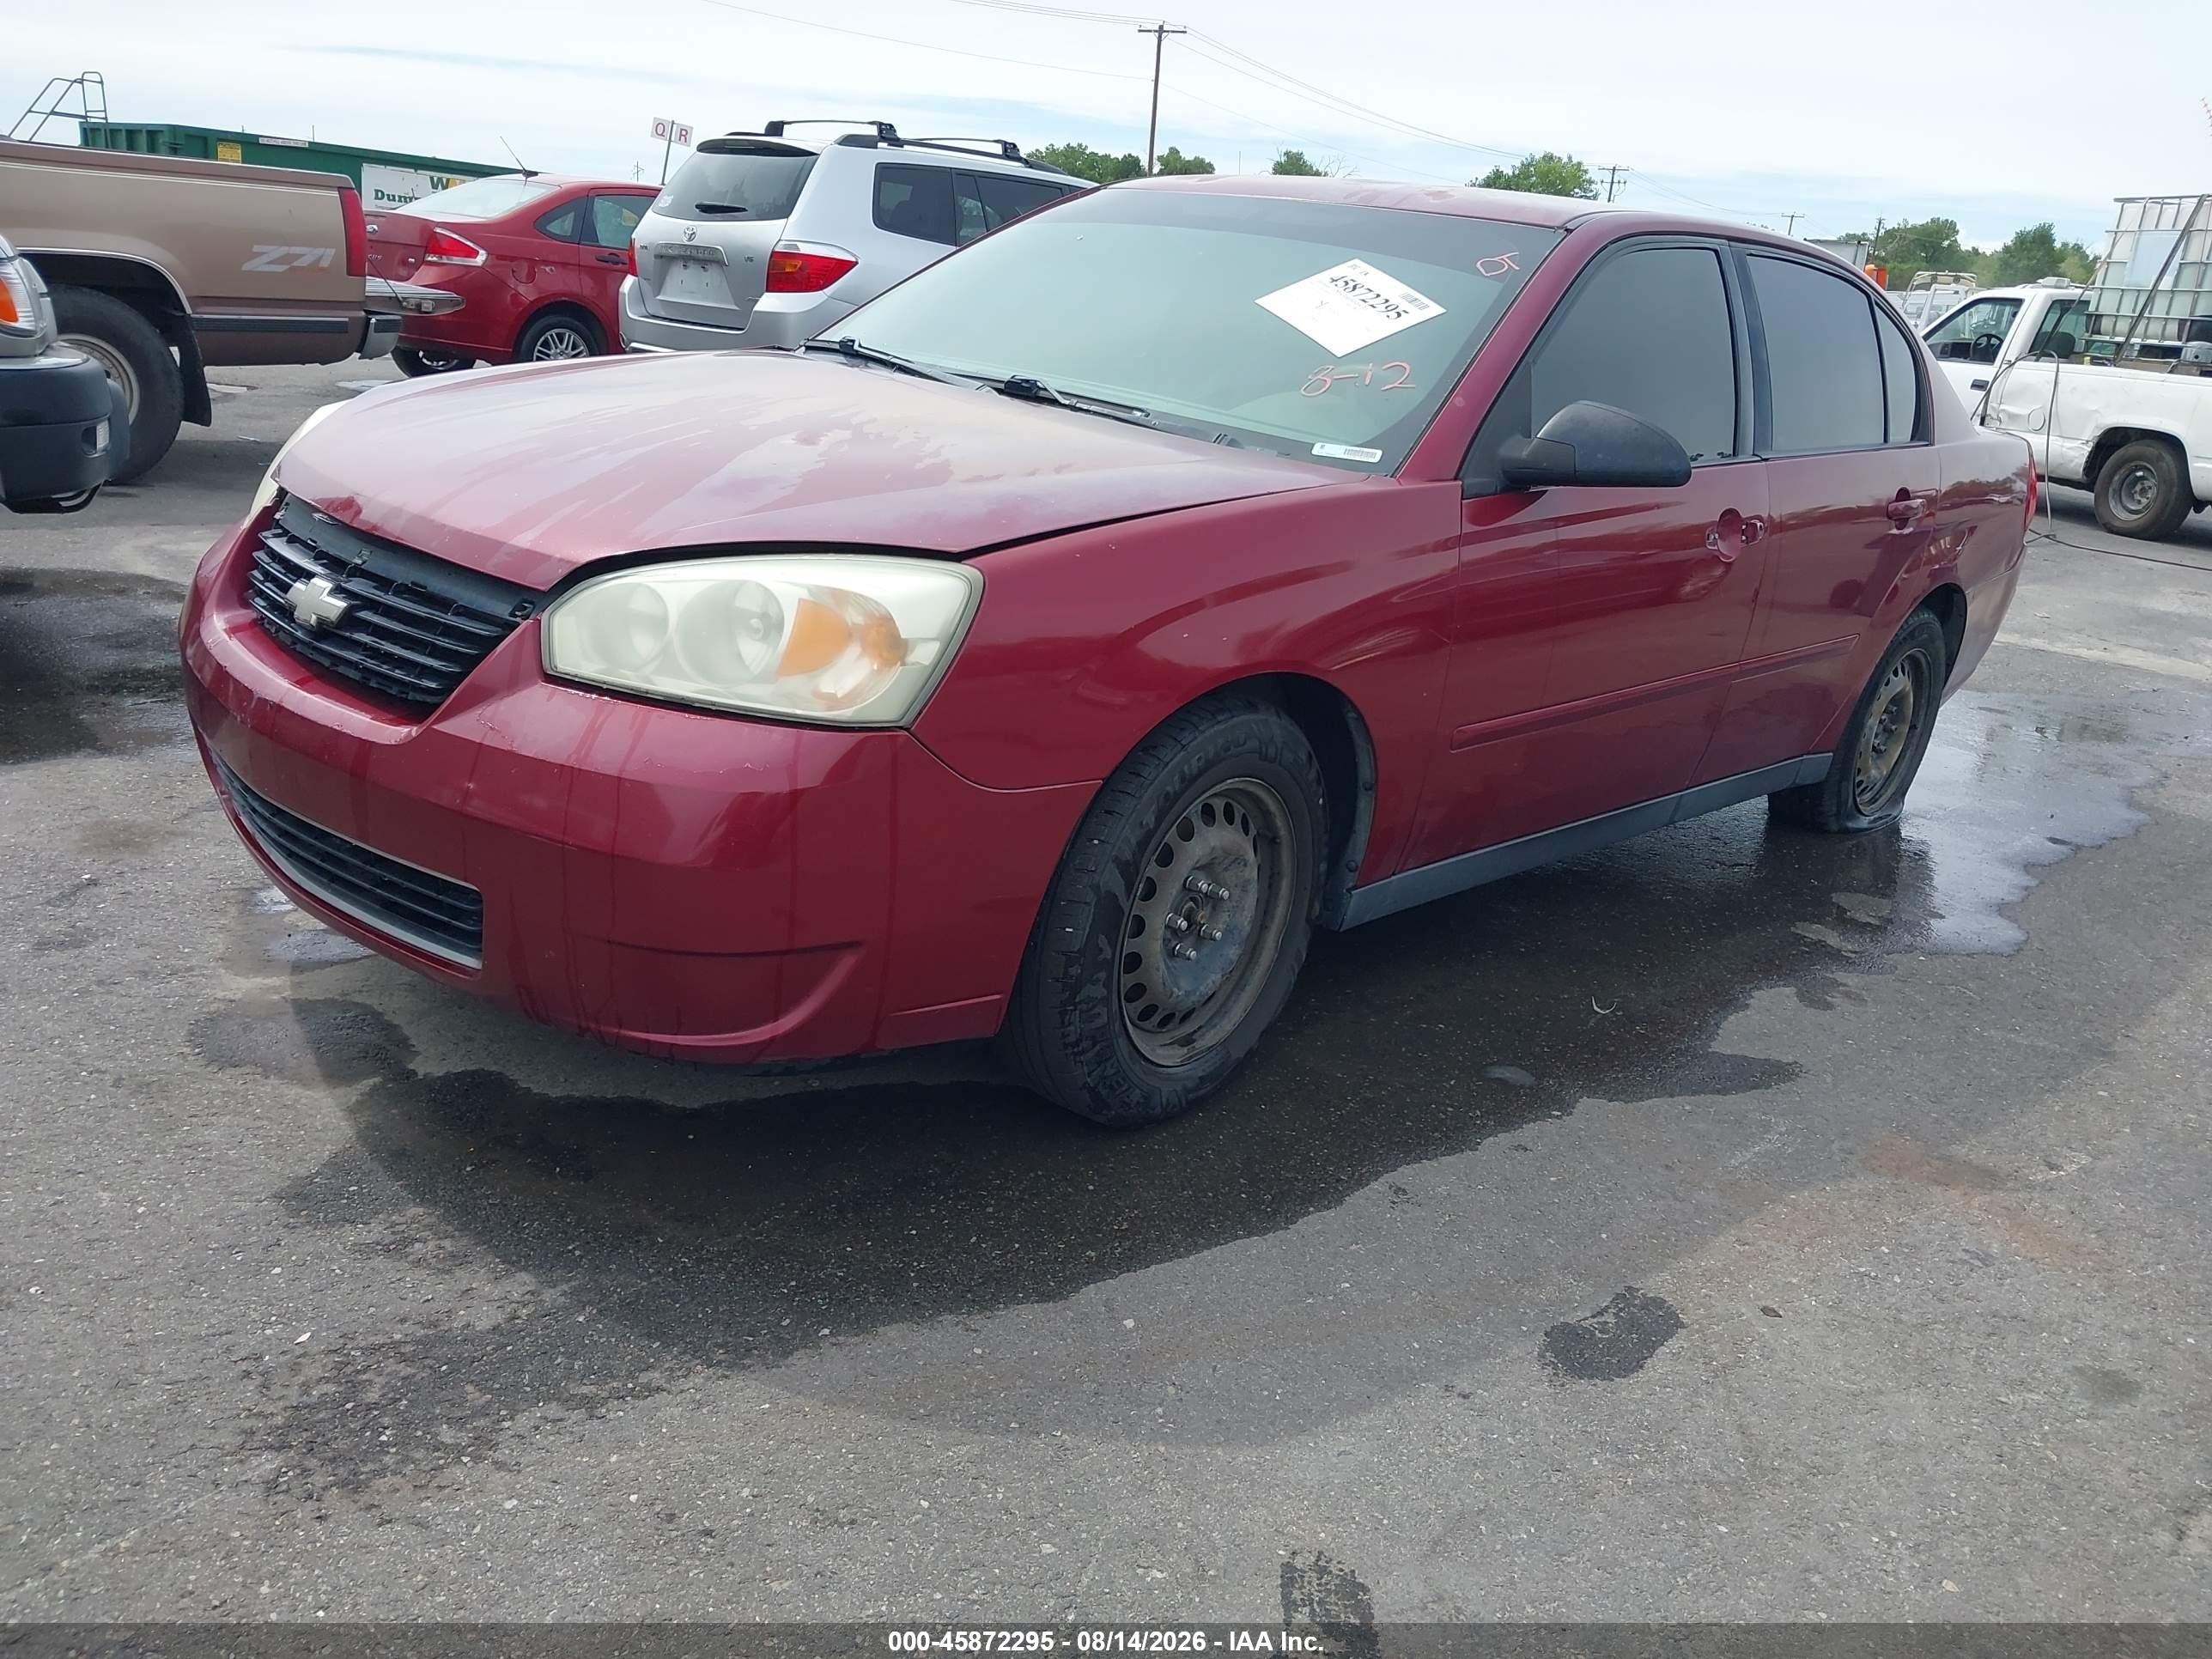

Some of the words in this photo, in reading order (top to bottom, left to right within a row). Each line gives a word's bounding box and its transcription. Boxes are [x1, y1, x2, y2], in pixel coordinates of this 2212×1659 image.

[655, 122, 665, 137] Q
[678, 127, 689, 143] R
[241, 245, 336, 272] Z71
[1328, 275, 1410, 320] 45872295
